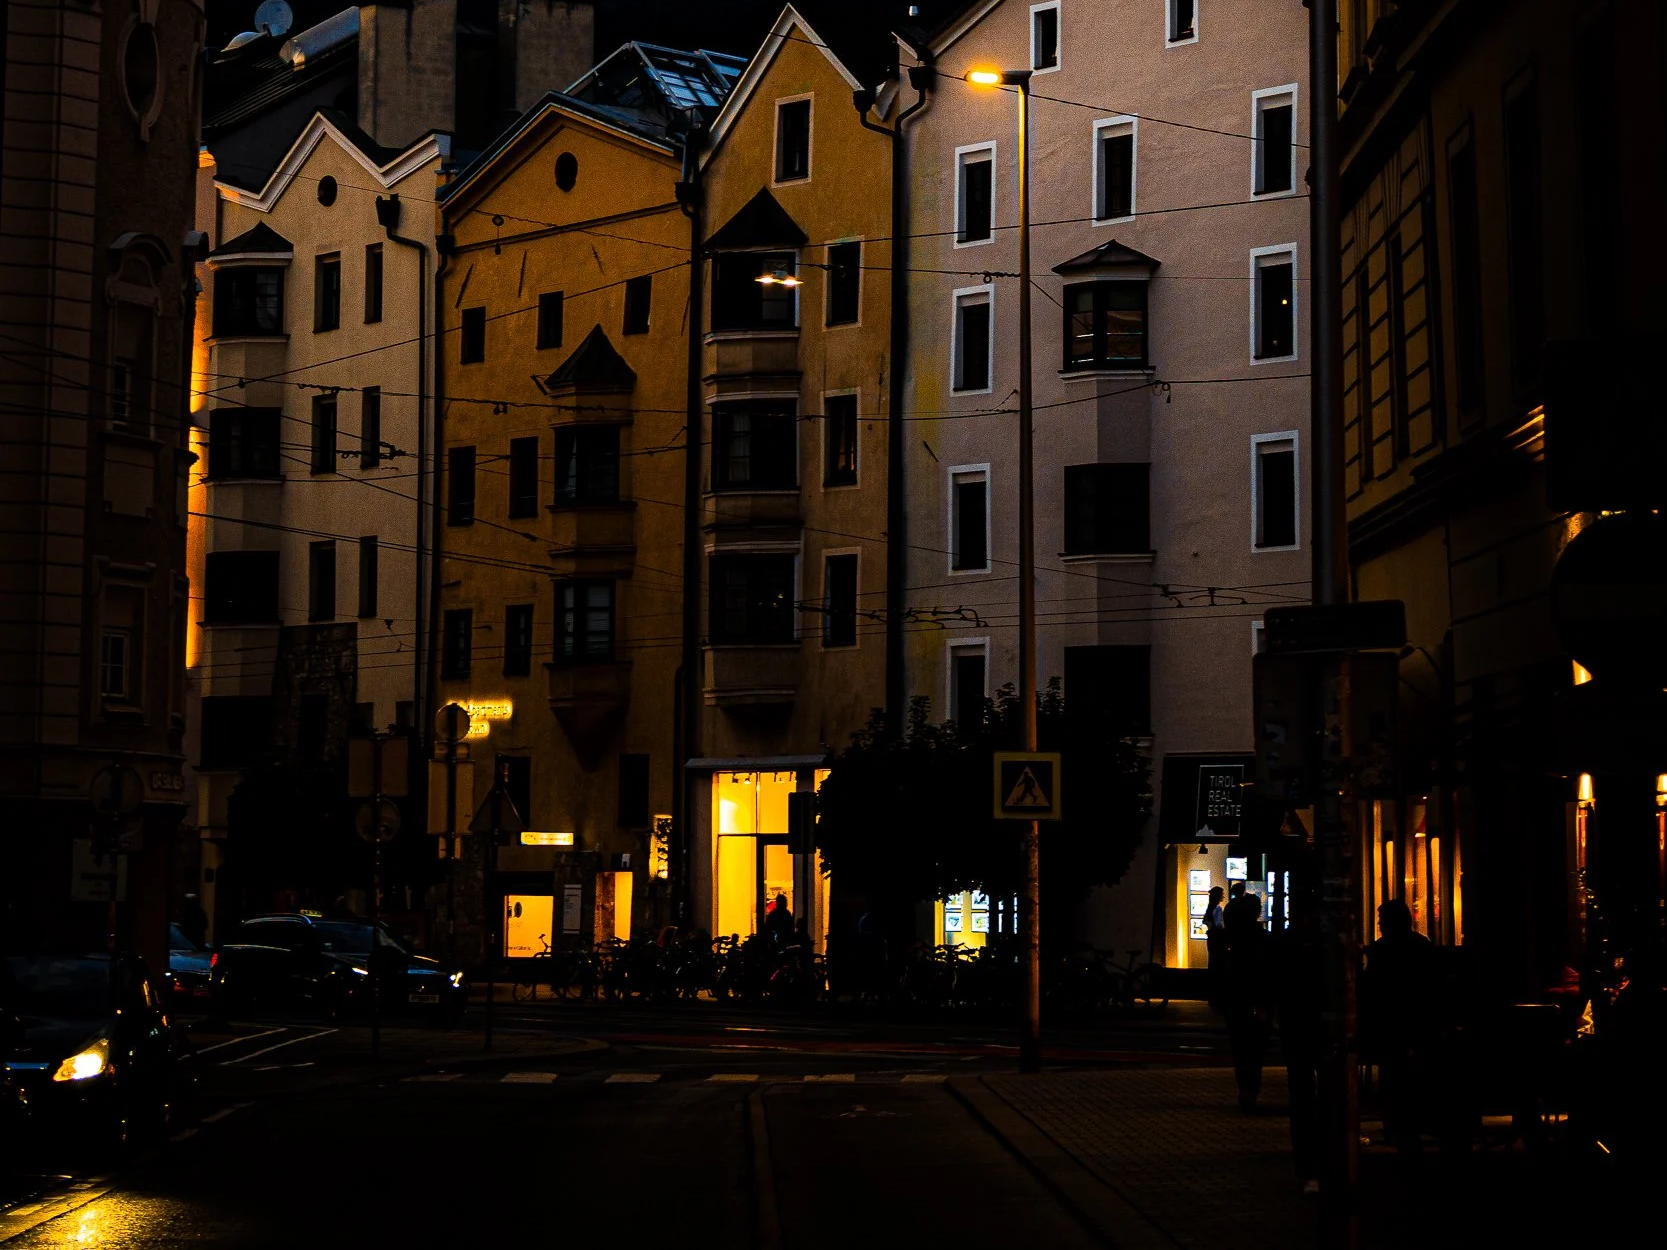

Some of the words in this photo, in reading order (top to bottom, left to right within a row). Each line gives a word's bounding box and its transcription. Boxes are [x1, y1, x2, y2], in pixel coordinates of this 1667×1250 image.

[1209, 775, 1236, 788] TIROL
[1208, 790, 1233, 802] REAL
[1207, 804, 1242, 817] ESTATE
